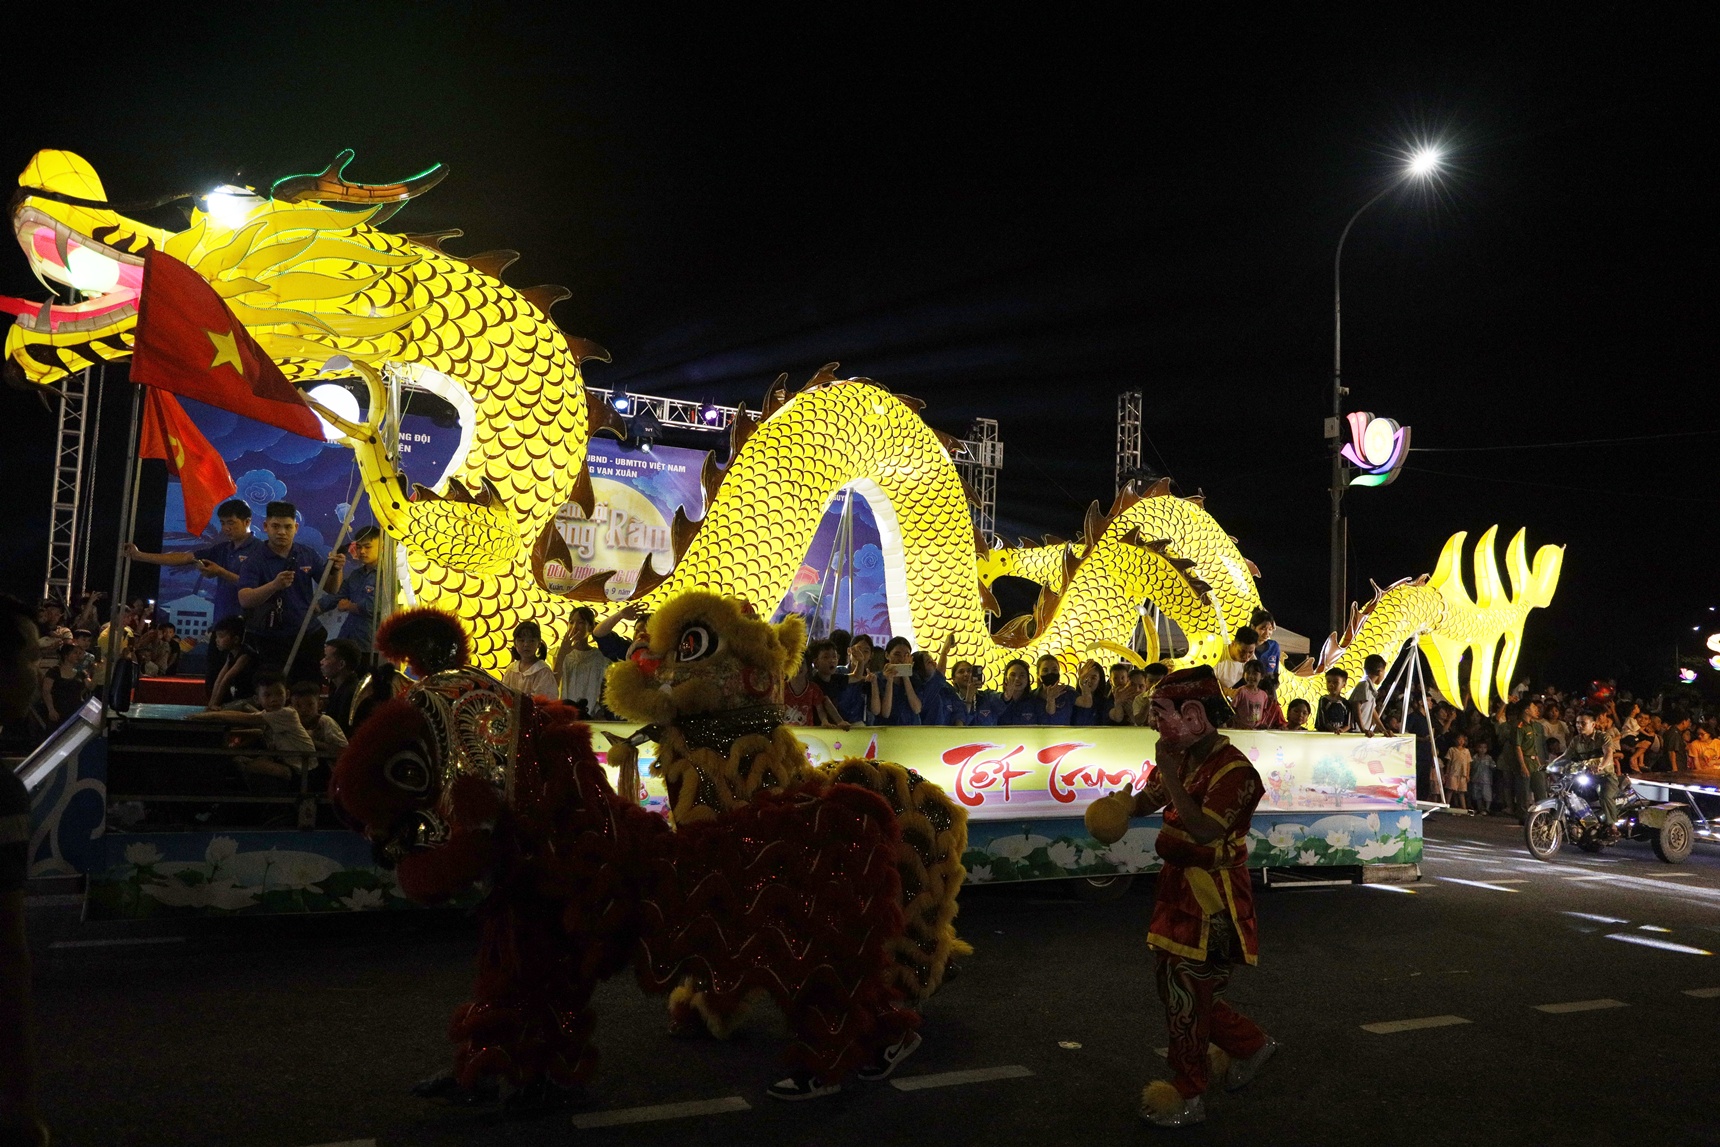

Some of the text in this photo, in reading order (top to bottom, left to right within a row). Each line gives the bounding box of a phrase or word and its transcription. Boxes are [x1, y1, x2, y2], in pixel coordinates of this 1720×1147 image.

[398, 432, 431, 444] NG ĐỘI
[398, 444, 411, 453] ÊN
[615, 458, 647, 469] UBMTTQ
[649, 462, 666, 471] VIỆT
[667, 464, 686, 473] NAM
[596, 467, 614, 476] VẠN
[615, 469, 638, 478] XUÂN
[942, 743, 1035, 807] Tết
